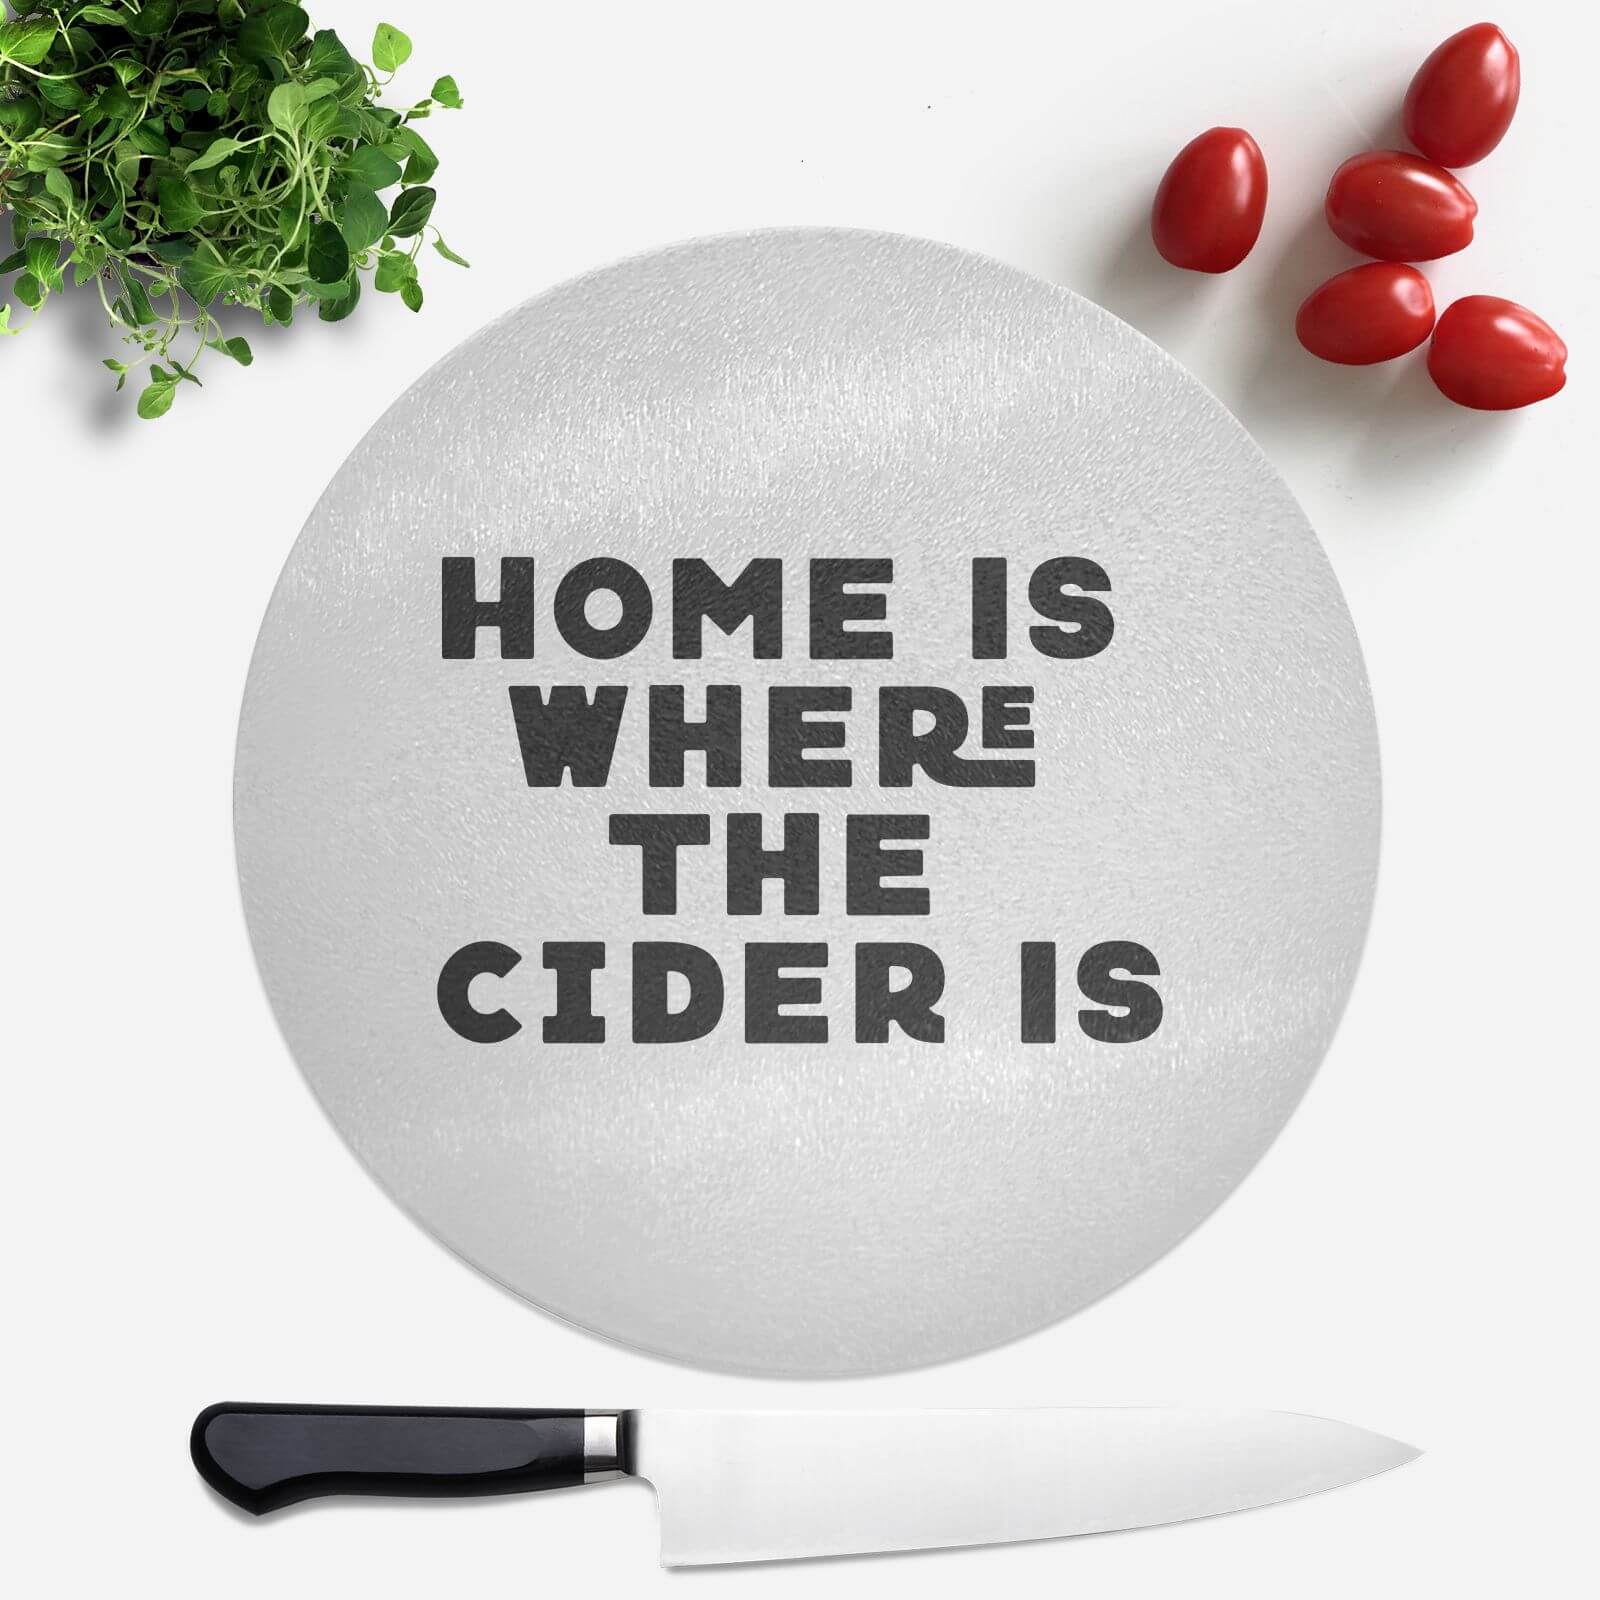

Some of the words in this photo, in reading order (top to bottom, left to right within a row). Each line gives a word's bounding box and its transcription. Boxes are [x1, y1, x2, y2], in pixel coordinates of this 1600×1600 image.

[441, 556, 894, 660] HOME
[971, 556, 1115, 660] IS
[508, 685, 1036, 788] WHERE
[608, 812, 931, 916] THE
[436, 940, 945, 1044] CIDER
[1020, 940, 1164, 1044] IS
